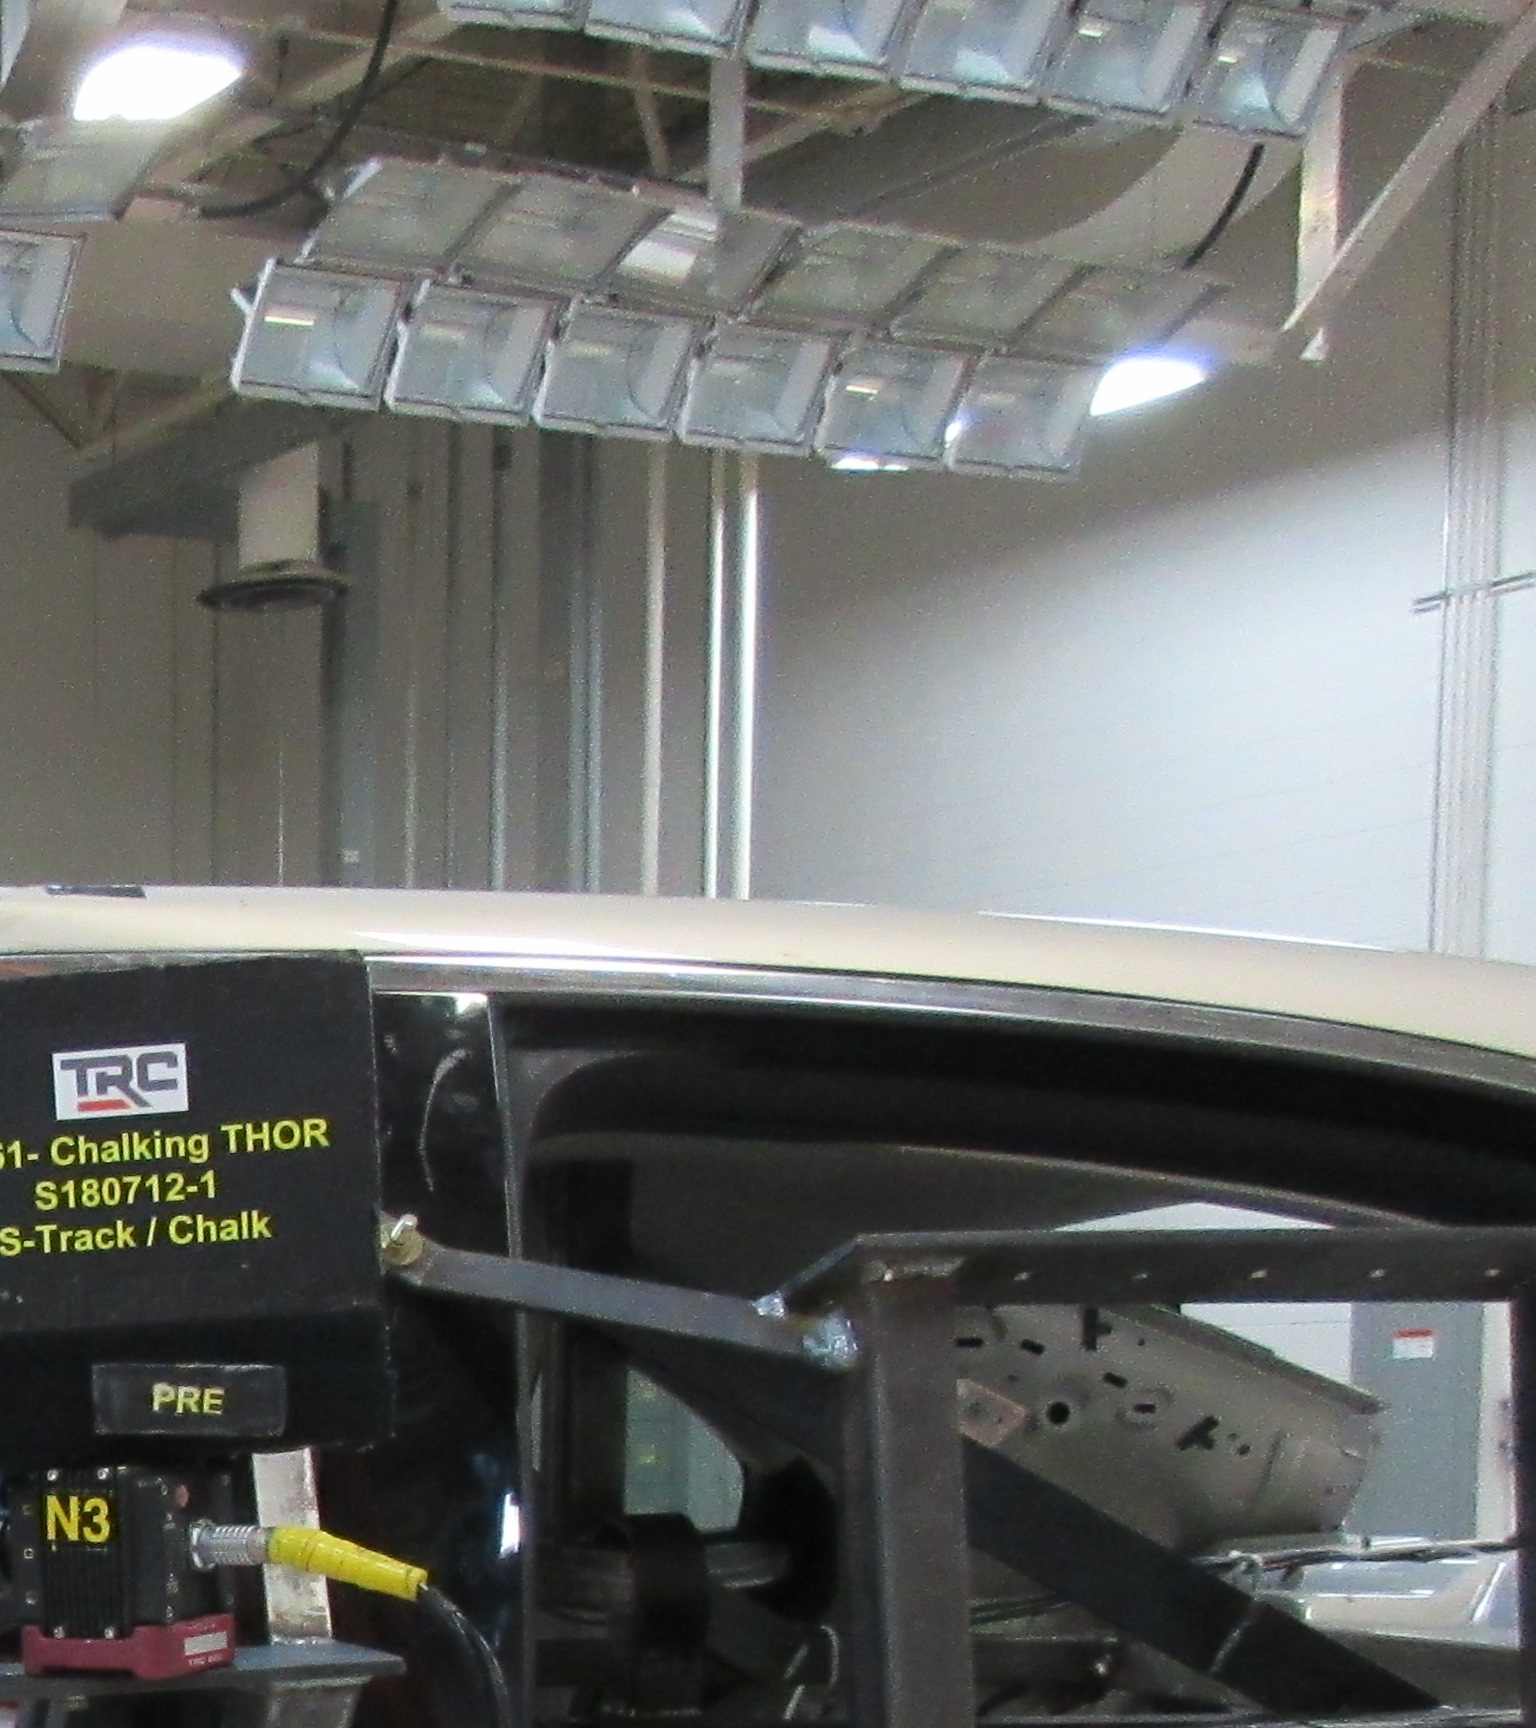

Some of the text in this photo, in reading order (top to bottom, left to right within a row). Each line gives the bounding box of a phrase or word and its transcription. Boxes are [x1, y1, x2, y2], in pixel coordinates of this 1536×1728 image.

[60, 1051, 179, 1108] TRC
[50, 1130, 210, 1166] Chalking
[220, 1117, 331, 1154] THOR
[35, 1169, 216, 1211] S180712-1
[168, 1209, 273, 1245] Chalk
[152, 1382, 226, 1415] PRE
[46, 1494, 111, 1543] N3
